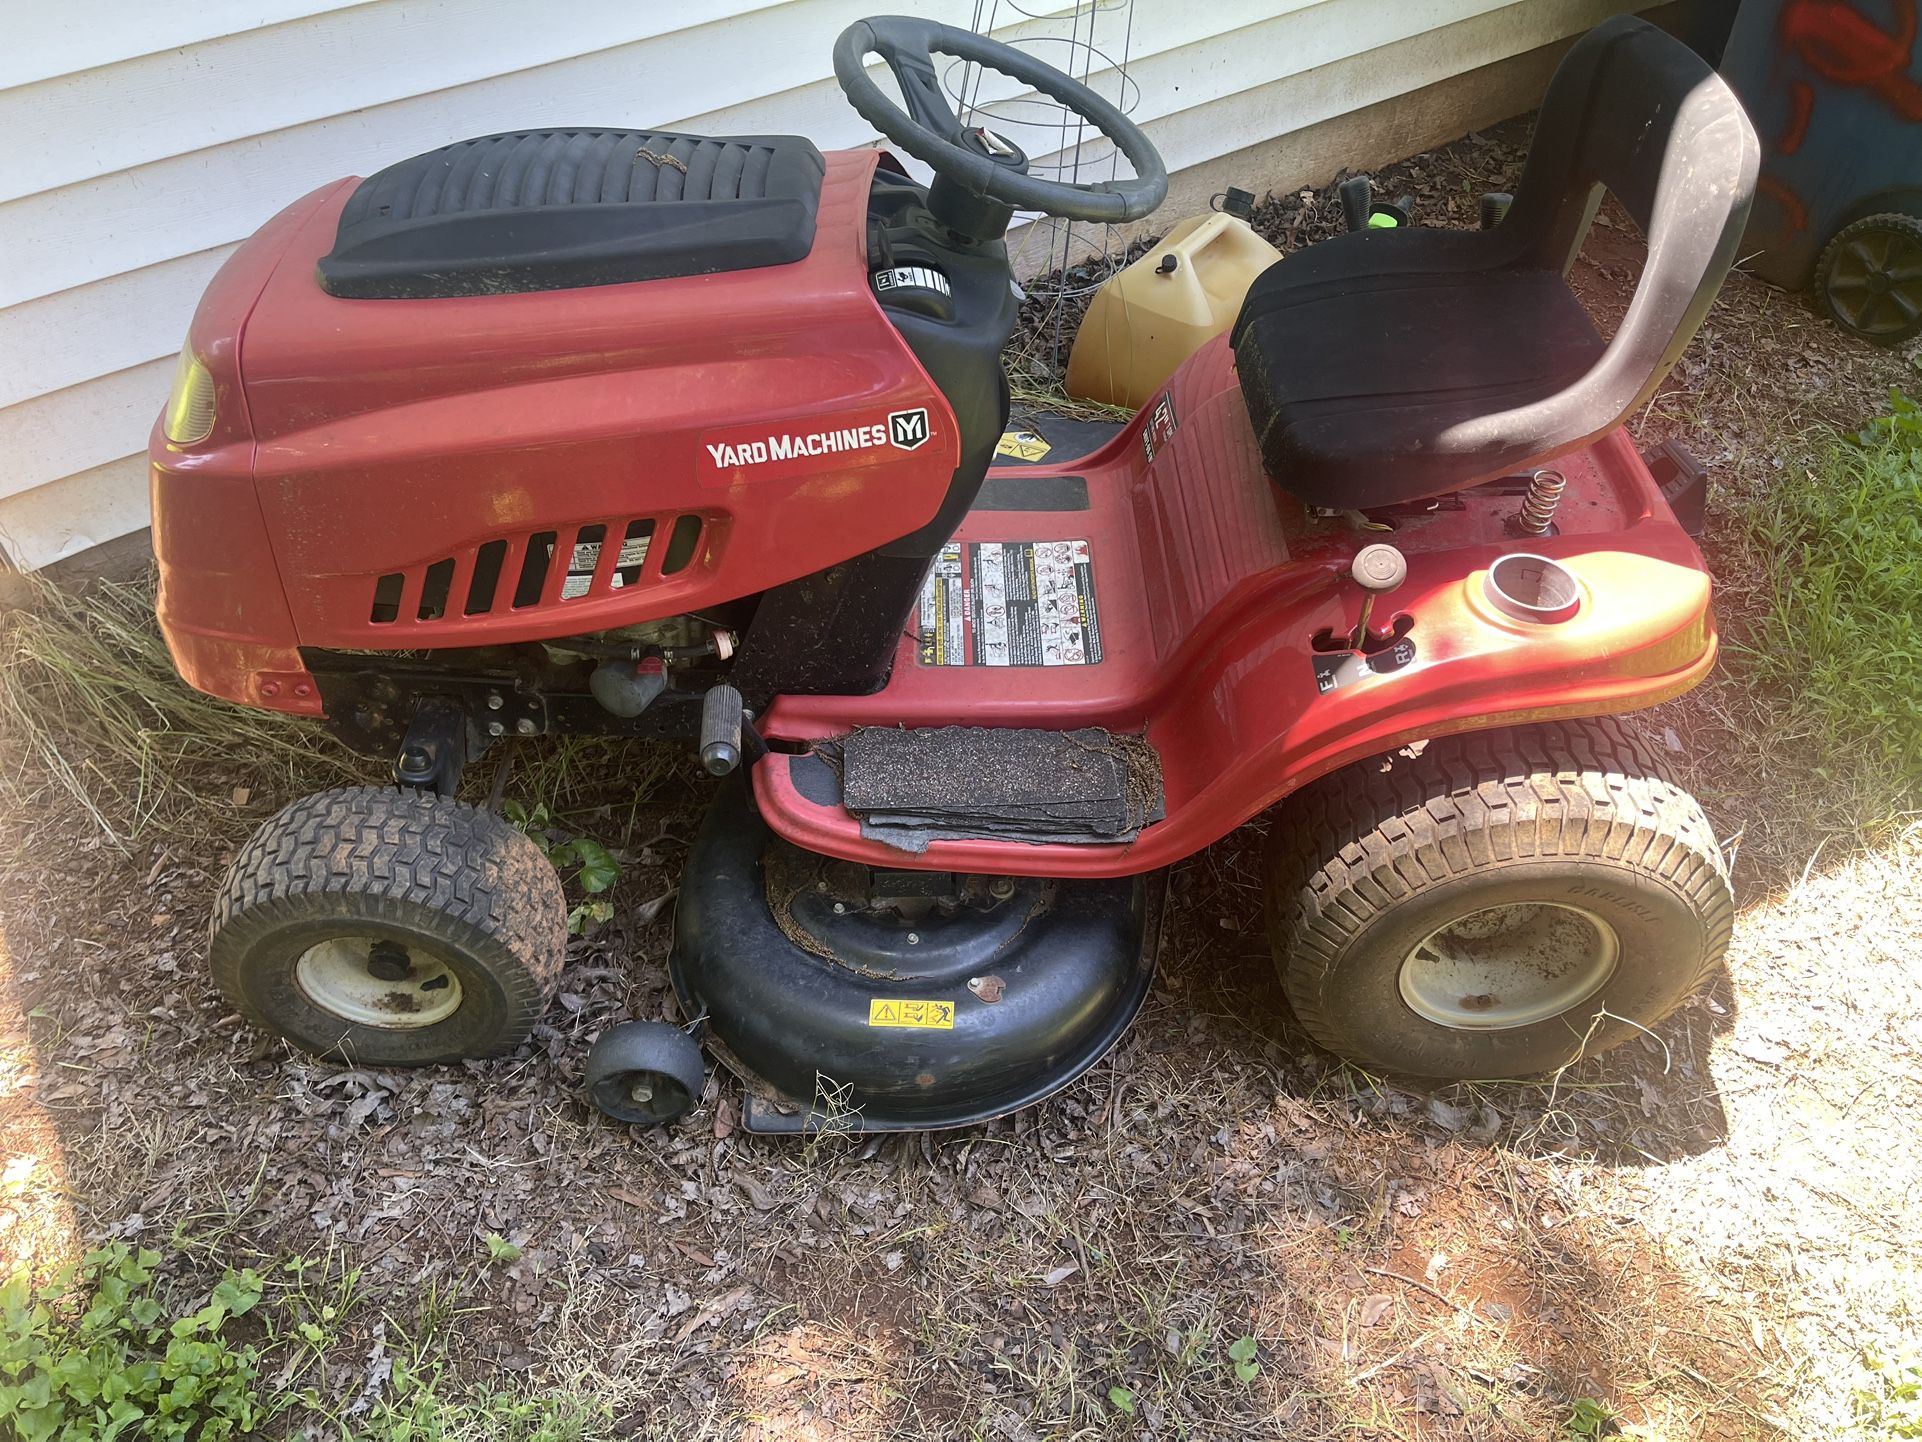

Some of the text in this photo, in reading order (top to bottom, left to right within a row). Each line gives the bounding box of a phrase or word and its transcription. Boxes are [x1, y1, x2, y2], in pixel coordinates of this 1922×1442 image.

[706, 442, 768, 468] YARD
[768, 424, 887, 461] MACHINES
[963, 588, 971, 615] DANGER
[1395, 651, 1410, 664] R
[1320, 681, 1333, 691] F
